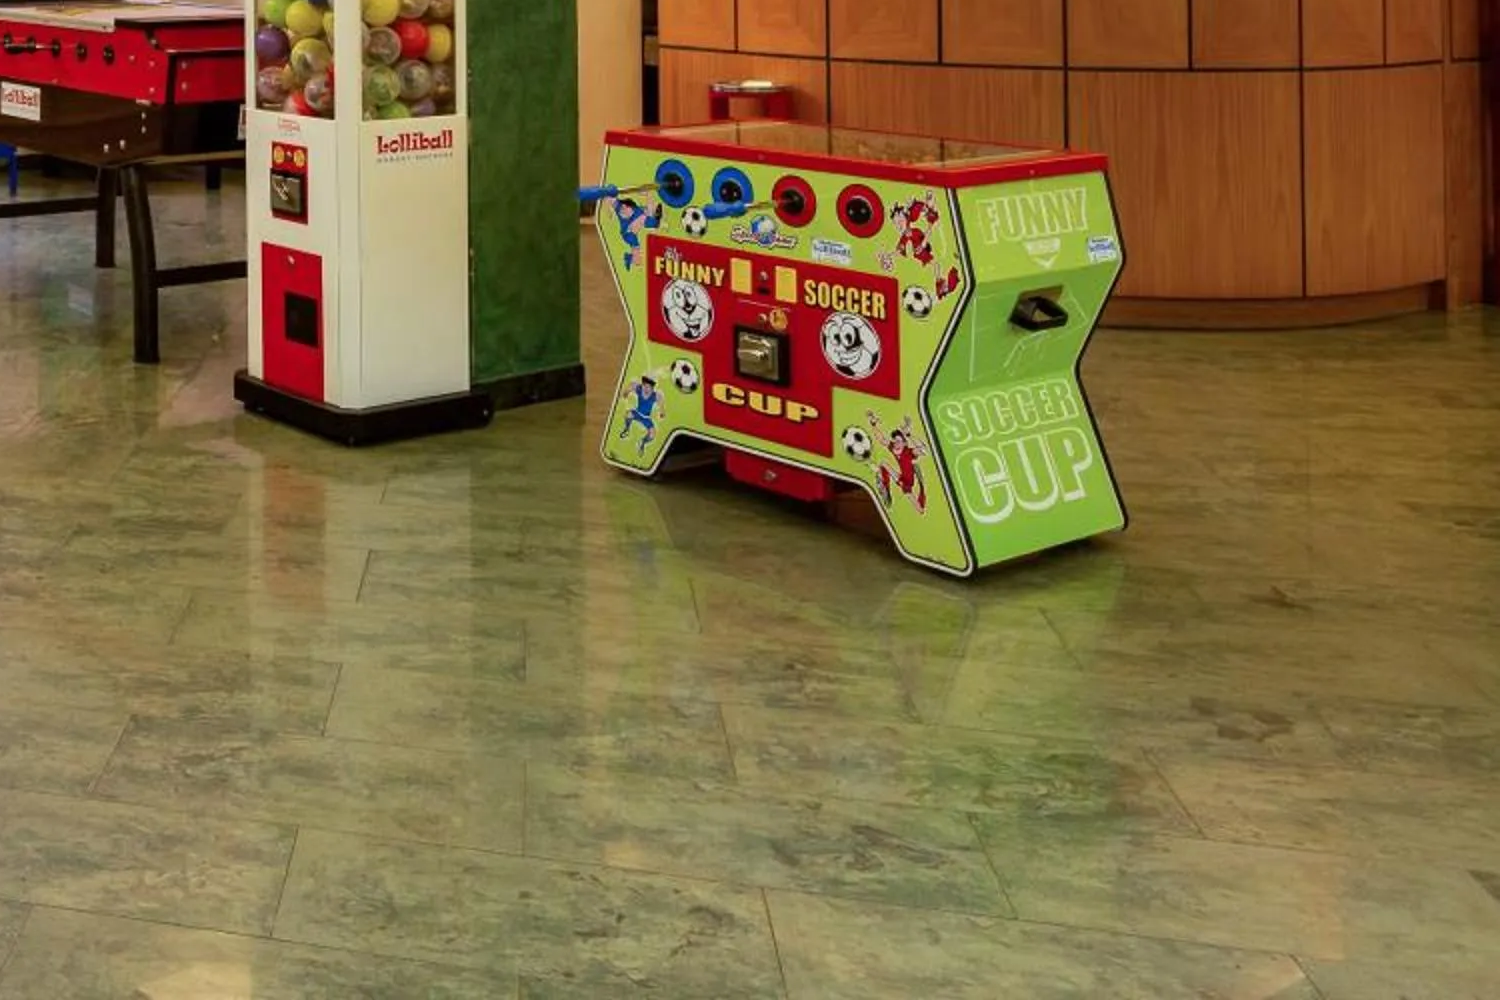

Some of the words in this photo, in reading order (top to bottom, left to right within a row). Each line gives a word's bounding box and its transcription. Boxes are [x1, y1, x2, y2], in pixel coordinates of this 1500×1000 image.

[976, 187, 1089, 245] FUNNY
[655, 256, 725, 288] FUNNY
[803, 278, 887, 320] SOCCER
[711, 382, 819, 424] CUP
[936, 378, 1080, 445] SOCCER
[954, 426, 1093, 524] CUP
